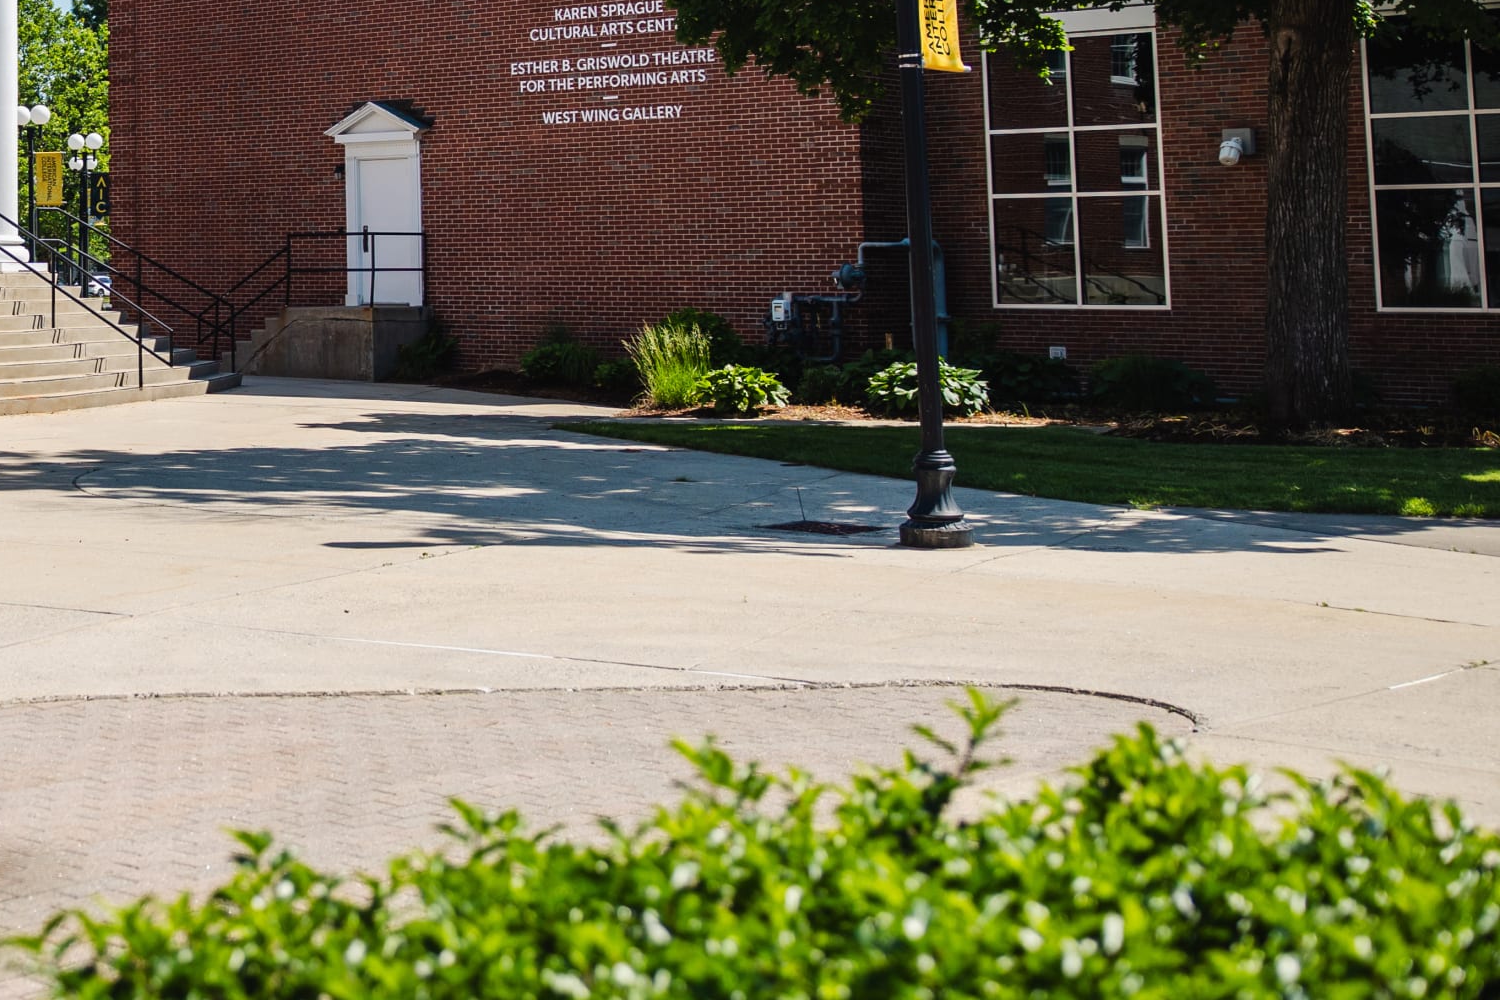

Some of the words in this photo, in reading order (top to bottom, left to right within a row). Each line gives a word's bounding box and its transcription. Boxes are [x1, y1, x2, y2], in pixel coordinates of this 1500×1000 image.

[554, 5, 598, 21] KAREN
[601, 0, 664, 17] SPRAGUE
[530, 24, 597, 42] CULTURAL
[600, 21, 634, 37] ARTS
[636, 18, 678, 34] CENT
[510, 60, 559, 75] ESTHER
[562, 58, 574, 72] B.
[577, 54, 650, 72] GRISWOLD
[652, 49, 715, 65] THEATRE
[520, 78, 545, 93] FOR
[548, 76, 575, 91] THE
[577, 71, 667, 90] PERFORMING
[670, 69, 706, 83] ARTS
[542, 110, 579, 125] WEST
[581, 107, 619, 123] WING
[622, 105, 683, 121] GALLERY
[96, 176, 107, 213] AIC
